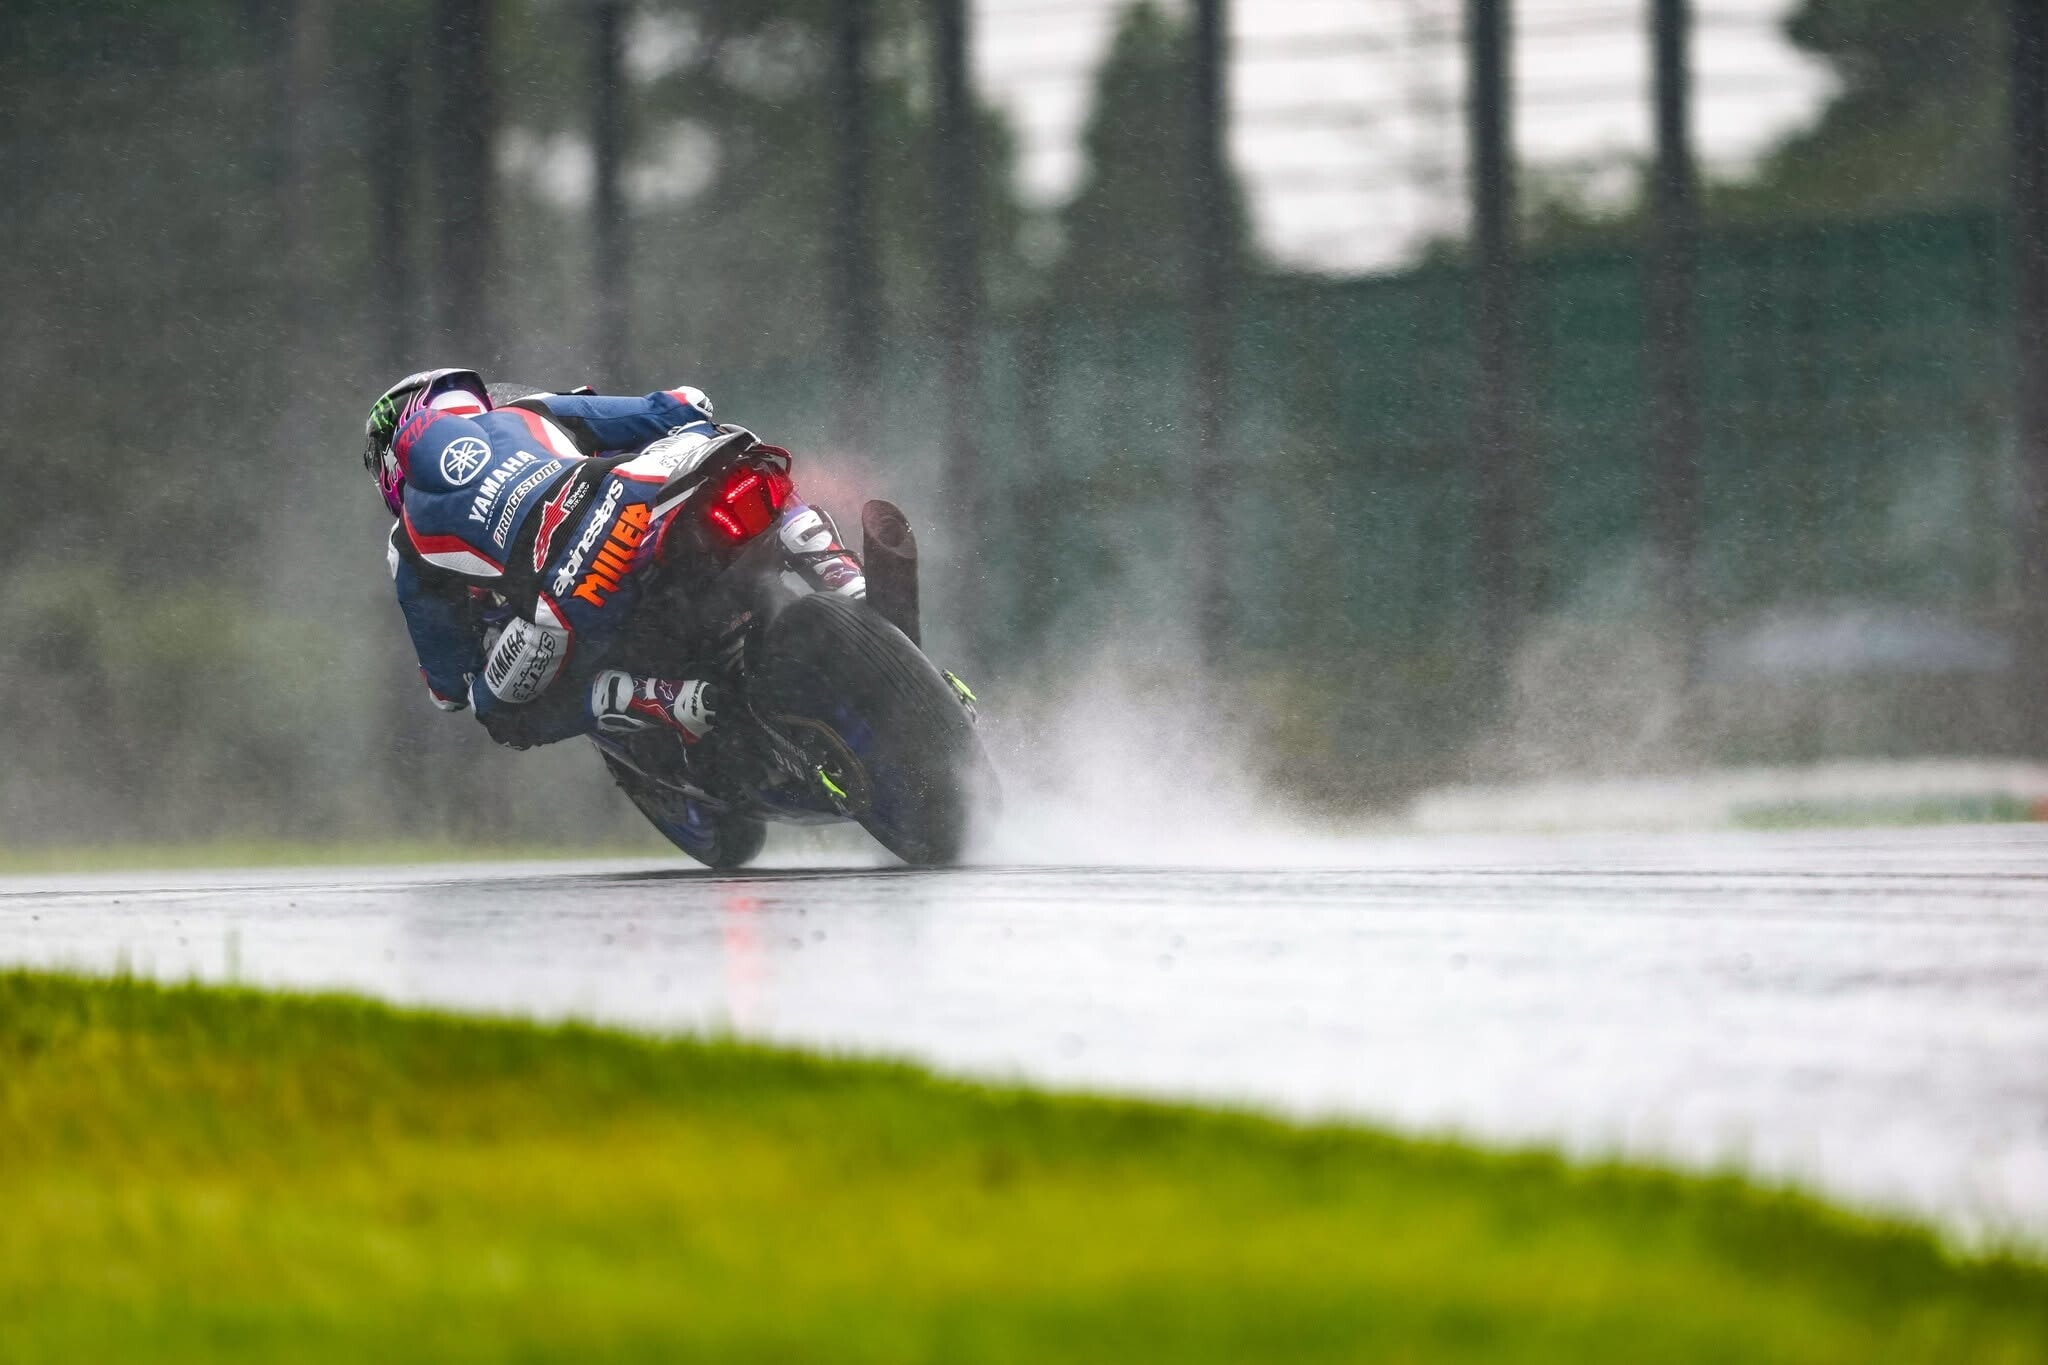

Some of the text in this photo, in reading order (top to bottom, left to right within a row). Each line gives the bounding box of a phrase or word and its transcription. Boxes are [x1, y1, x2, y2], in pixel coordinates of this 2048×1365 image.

[469, 450, 537, 523] YAMAHA
[493, 459, 562, 549] BRIDGESTONE
[553, 479, 624, 597] alpinestars
[573, 503, 653, 608] MILLER
[487, 630, 526, 689] YAMAHA
